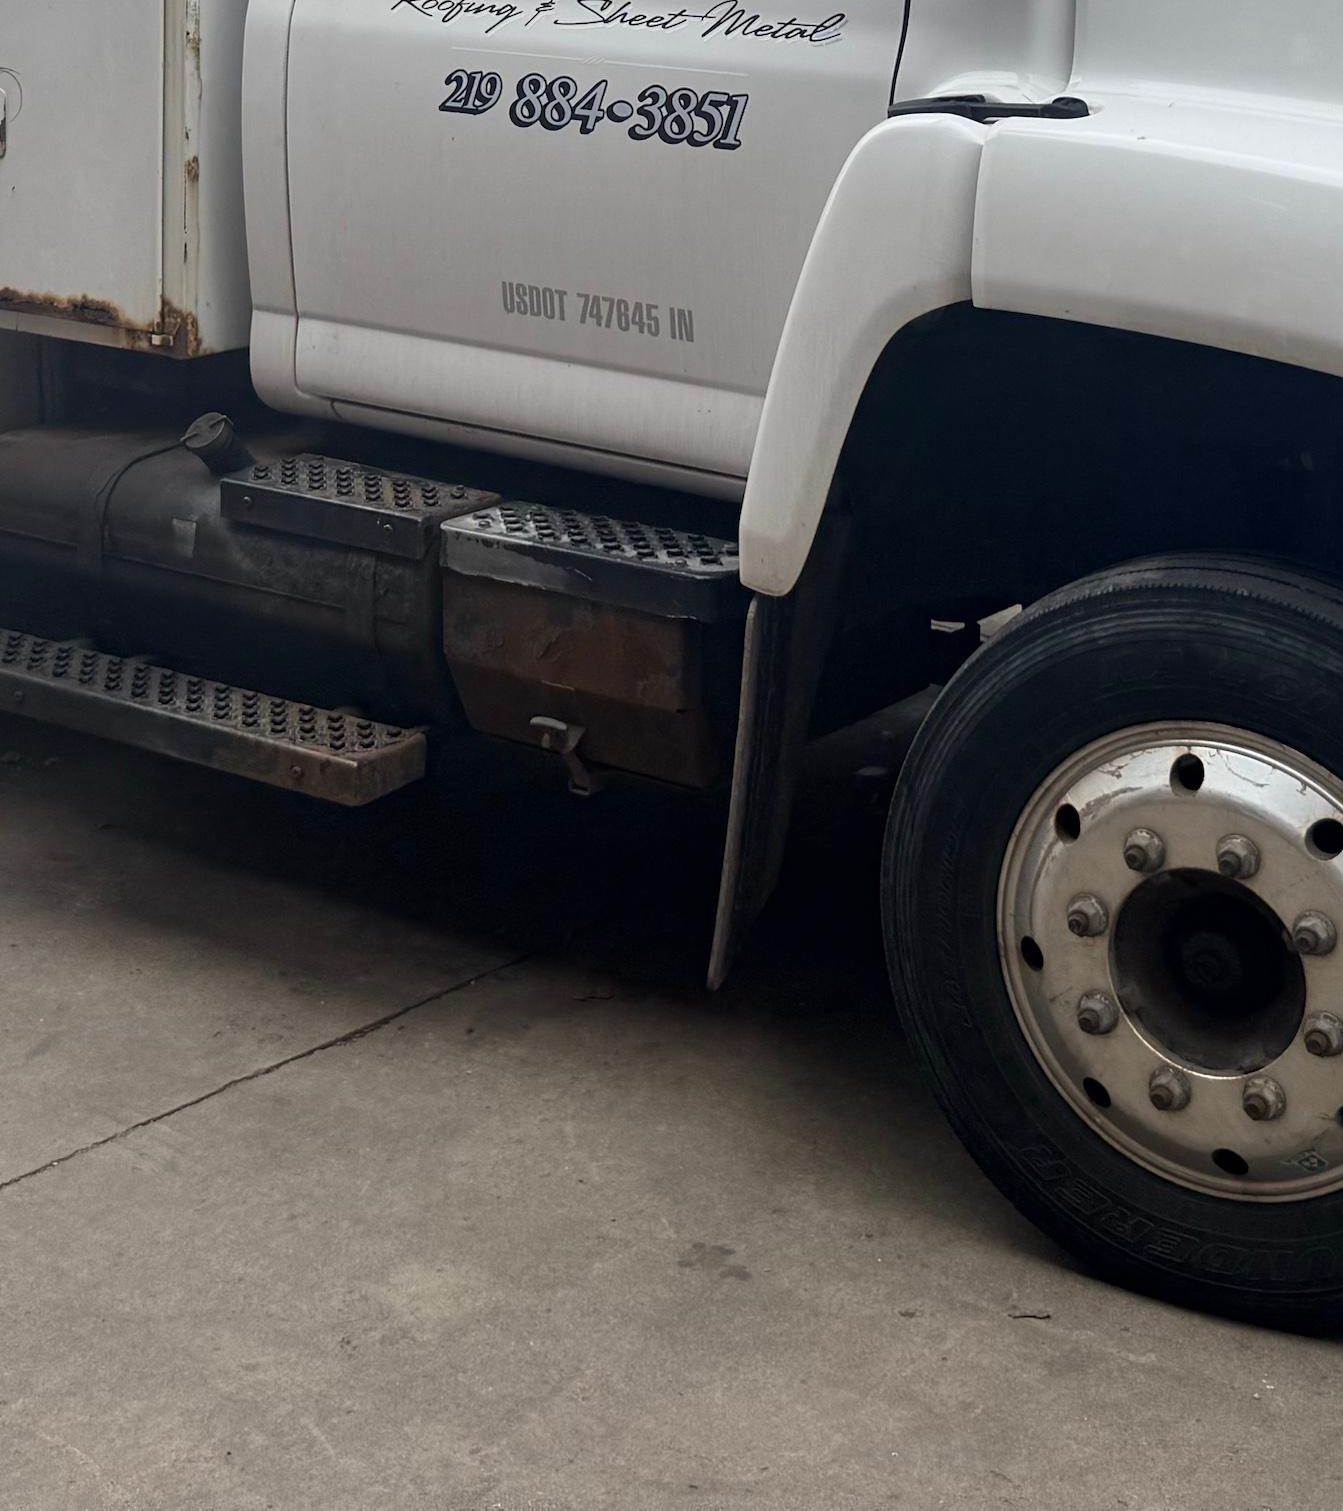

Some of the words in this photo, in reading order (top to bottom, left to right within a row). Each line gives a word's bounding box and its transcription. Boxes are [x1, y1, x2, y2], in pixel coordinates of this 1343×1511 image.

[696, 0, 847, 42] Metal
[439, 69, 503, 114] 219
[501, 280, 568, 321] USDOT
[668, 306, 695, 343] IN
